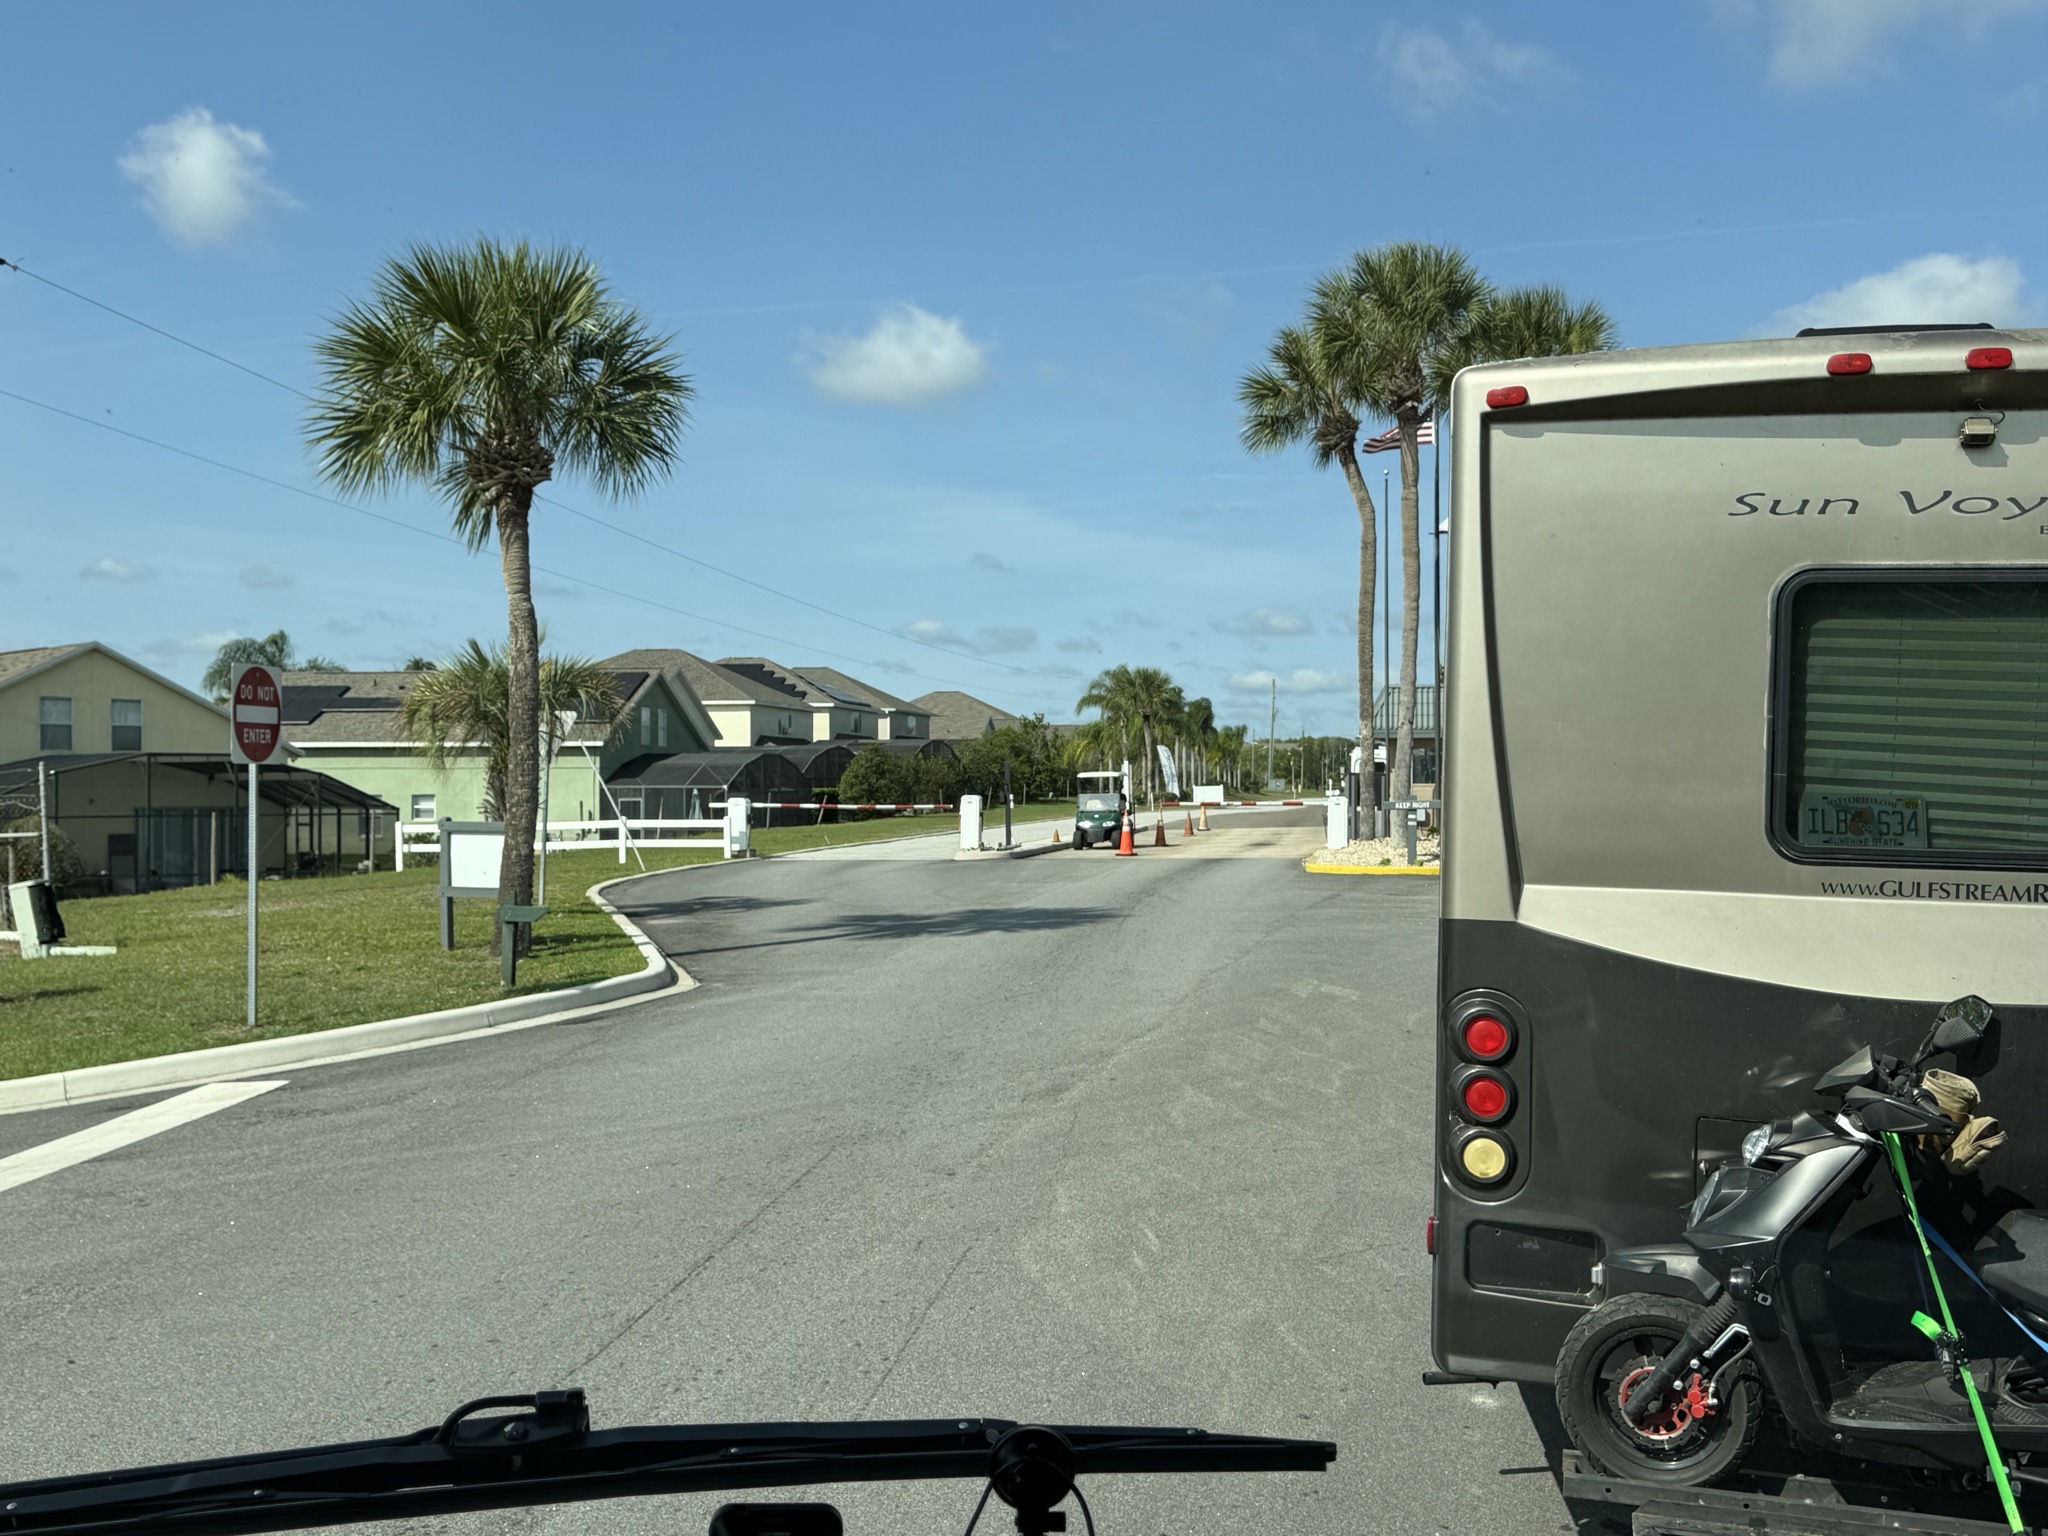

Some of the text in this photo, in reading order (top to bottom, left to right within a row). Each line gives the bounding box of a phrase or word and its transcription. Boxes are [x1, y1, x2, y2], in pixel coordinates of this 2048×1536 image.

[1728, 490, 2048, 521] Sun Voy
[240, 684, 275, 701] DO NOT
[243, 728, 272, 743] ENTER
[1808, 808, 1919, 837] ILB S34
[1829, 837, 1899, 847] SUNSHINE STATE
